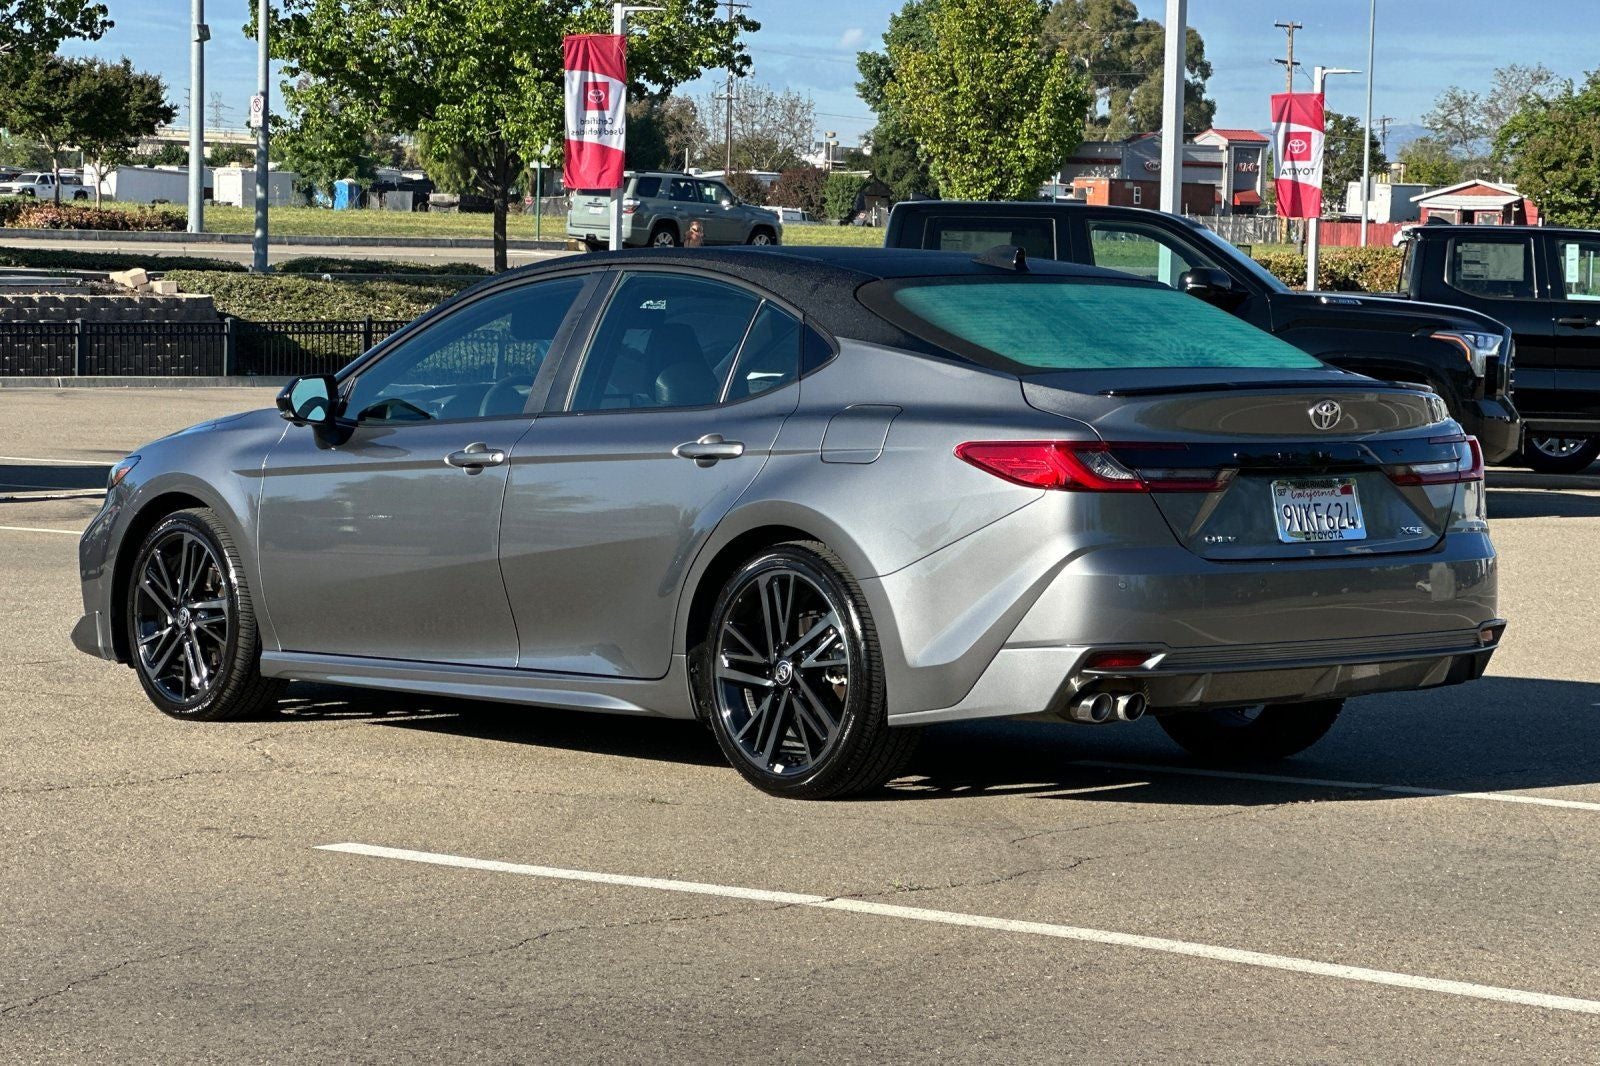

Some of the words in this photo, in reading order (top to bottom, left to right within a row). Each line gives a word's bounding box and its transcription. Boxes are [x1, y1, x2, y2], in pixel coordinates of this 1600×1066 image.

[1291, 490, 1337, 502] California
[1283, 502, 1357, 532] 9VKF624
[1313, 531, 1344, 540] TOYOTA
[1400, 526, 1423, 535] XSE
